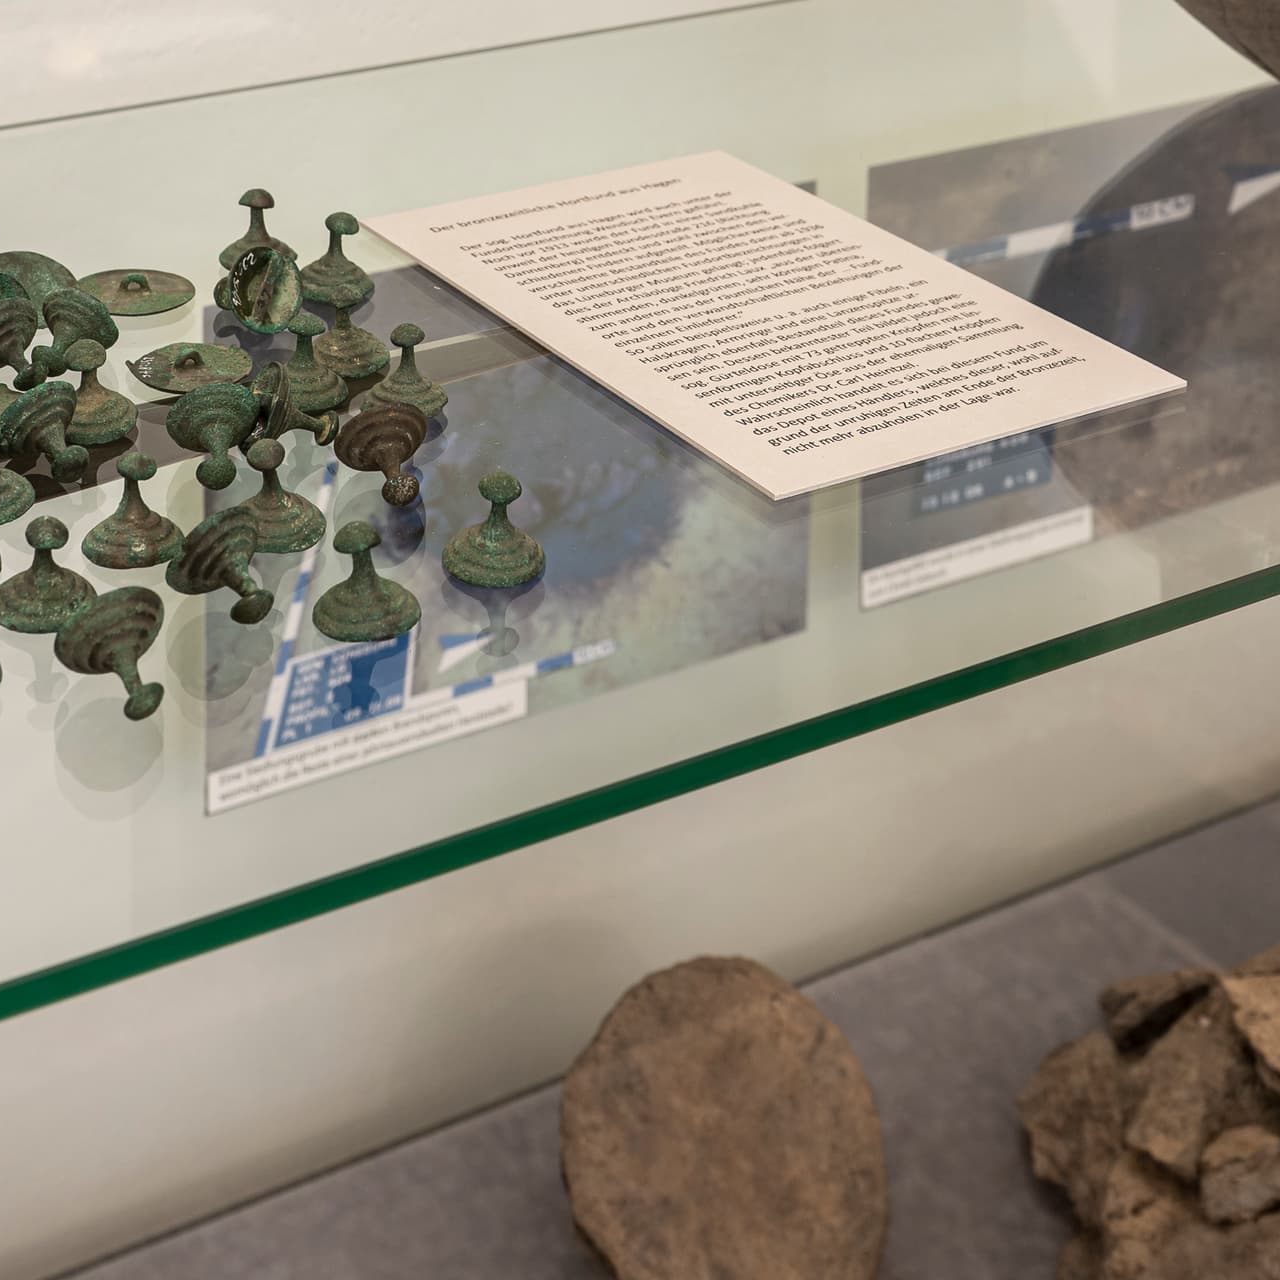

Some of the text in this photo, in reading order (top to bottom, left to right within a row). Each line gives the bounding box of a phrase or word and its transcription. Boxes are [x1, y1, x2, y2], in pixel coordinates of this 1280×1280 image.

[428, 224, 454, 233] Der
[493, 258, 538, 272] unweit
[503, 257, 585, 279] Dannenberg)
[516, 267, 586, 286] schiedenen
[527, 272, 609, 293] verschiedene
[539, 265, 682, 301] unter unterschiedlichen
[552, 299, 576, 308] das
[645, 271, 701, 286] Museum
[564, 306, 592, 316] dies
[592, 300, 613, 310] der
[576, 302, 659, 324] stimmenden,
[588, 322, 618, 332] zum
[617, 308, 671, 325] anderen
[670, 303, 695, 312] aus
[694, 297, 716, 306] der
[601, 329, 630, 340] orte
[630, 321, 657, 333] und
[657, 316, 683, 326] den
[682, 286, 810, 320] verwandtschaftlichen
[638, 343, 716, 364] Halskragen,
[714, 328, 774, 346] Armringe
[773, 320, 800, 331] und
[799, 314, 828, 325] eine
[825, 296, 902, 318] Lanzenspitze
[645, 338, 685, 352] sollen
[682, 317, 774, 342] beispielsweise
[800, 302, 832, 314] auch
[831, 294, 868, 306] einige
[720, 338, 779, 356] ebenfalls
[776, 320, 846, 342] Bestandteil
[846, 312, 886, 325] dieses
[882, 301, 929, 315] Fundes
[614, 329, 676, 348] einzelnen
[666, 300, 978, 382] sen sein. Dessen bekanntester Teil bildet jedoch eine
[680, 380, 710, 390] sog.
[780, 354, 806, 364] mit
[802, 349, 822, 358] 73
[822, 333, 891, 355] getreppten
[940, 314, 964, 324] mit
[774, 352, 864, 378] Kopfabschluss
[863, 344, 890, 355] und
[888, 339, 907, 348] 10
[904, 329, 952, 344] flachen
[708, 322, 1024, 408] mit unterseitiger Öse aus der ehemaligen Sammlung
[723, 361, 920, 417] des Chemikers Dr. Carl Heintzel.
[735, 396, 838, 426] Wahrscheinlich
[834, 382, 888, 400] handelt
[903, 370, 930, 382] sich
[926, 365, 952, 375] bei
[950, 354, 996, 370] diesem
[992, 344, 1027, 358] Fund
[1025, 340, 1049, 349] um
[752, 425, 778, 436] das
[776, 413, 822, 429] Depot
[820, 403, 857, 418] eines
[916, 374, 969, 391] welches
[967, 363, 1011, 378] dieser,
[1007, 353, 1041, 366] wohl
[1039, 347, 1063, 358] auf-
[767, 356, 1086, 447] grund der unruhigen Zeiten am Ende der Bronzezeit,
[782, 386, 1020, 456] nicht mehr abzuholen in der Lage war.
